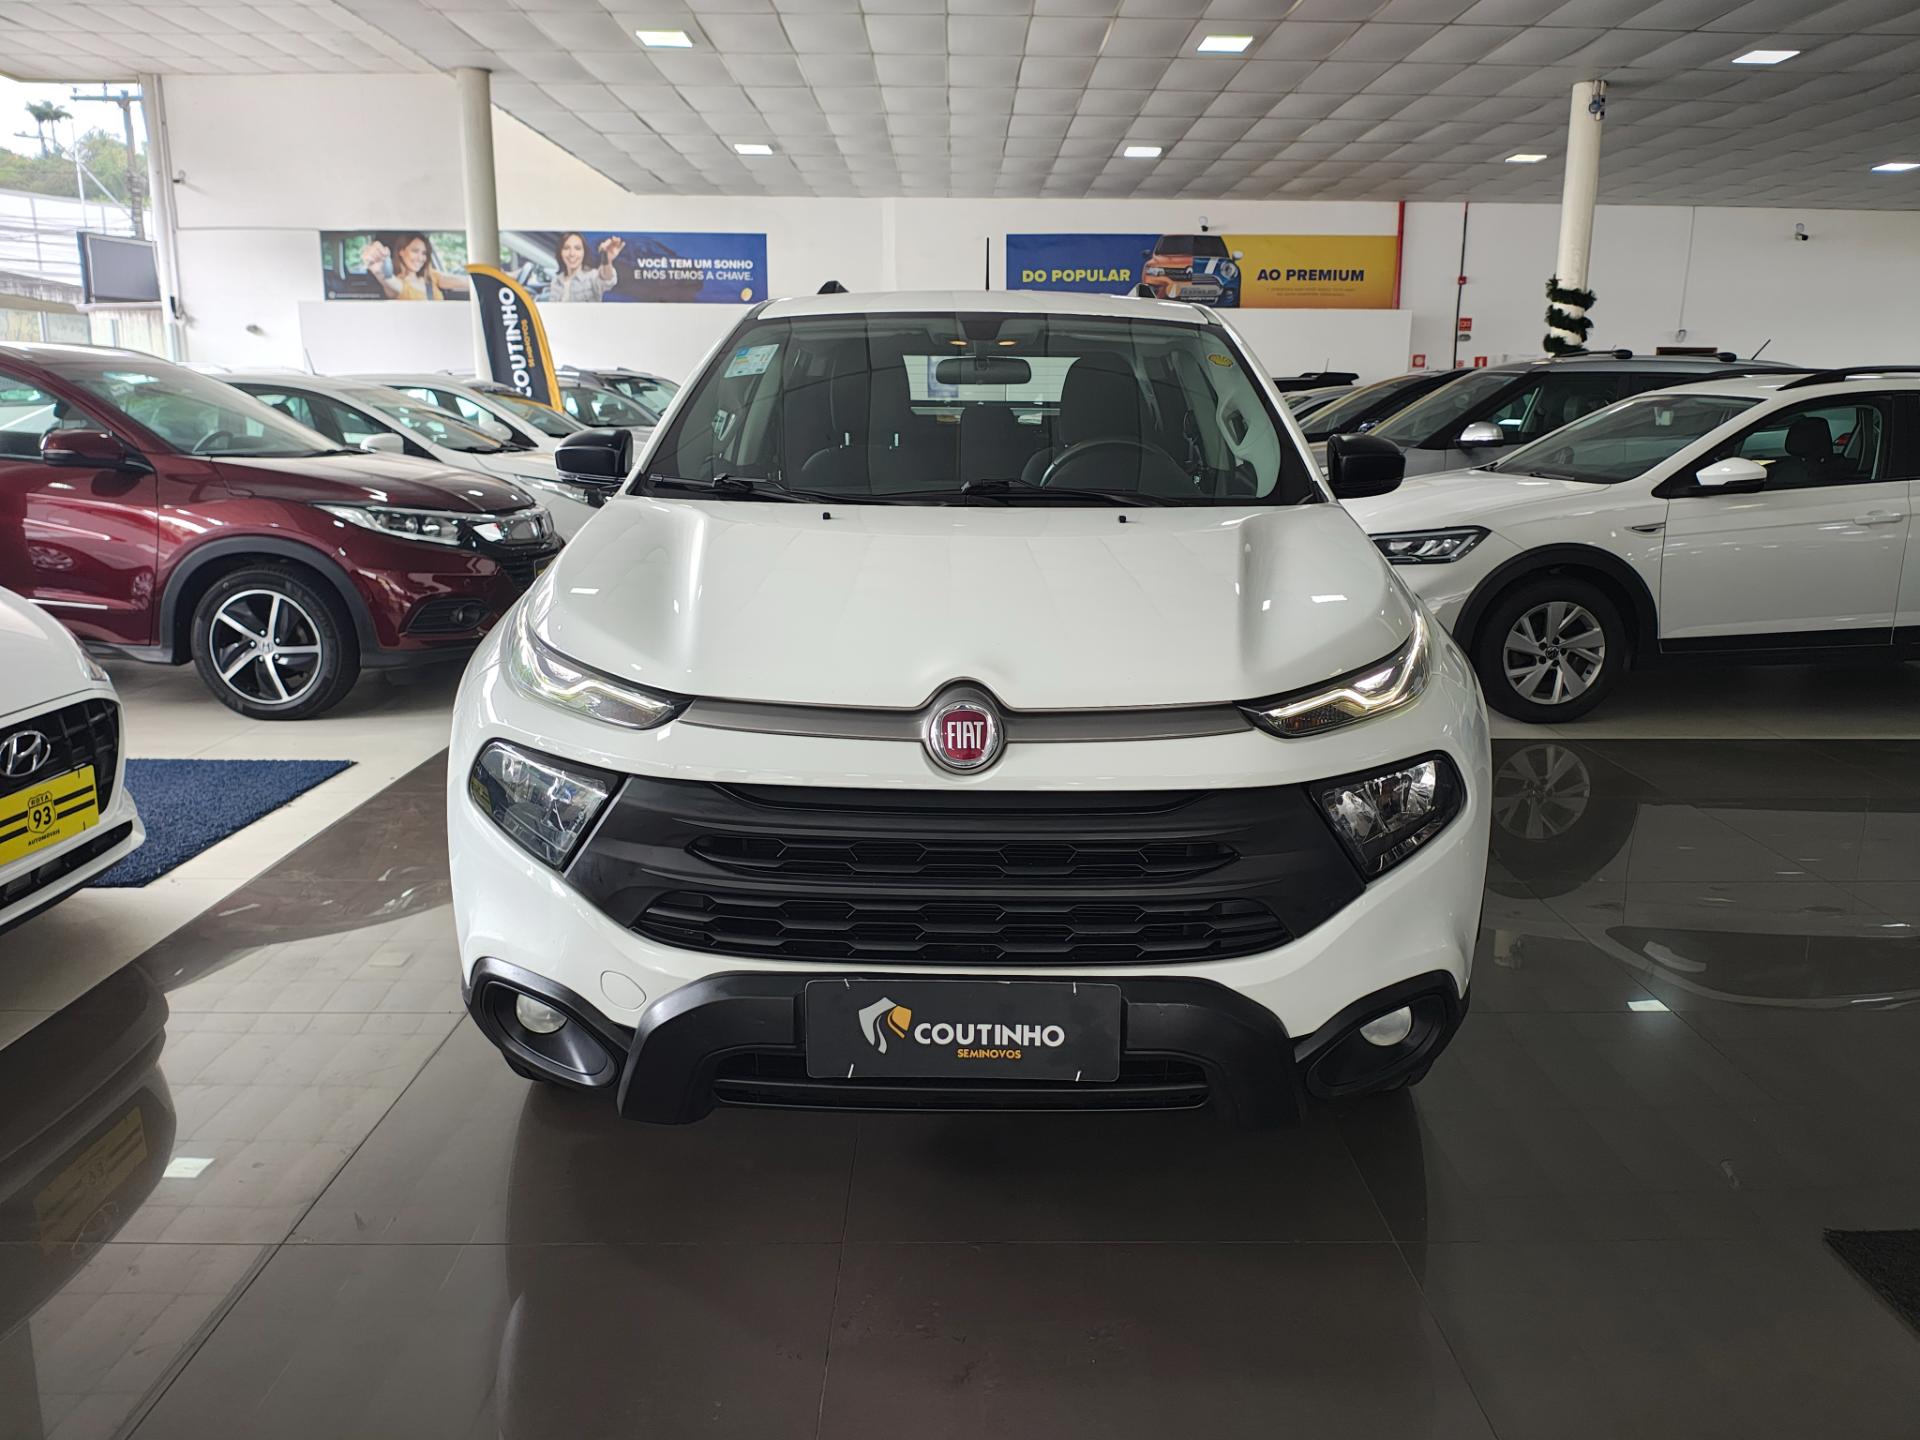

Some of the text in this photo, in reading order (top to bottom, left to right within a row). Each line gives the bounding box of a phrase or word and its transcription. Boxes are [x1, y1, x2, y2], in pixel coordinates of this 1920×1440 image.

[637, 257, 753, 270] VOCÊ TEM UM SONHO
[634, 269, 753, 281] E NÓS TEMOS A CHAVE.
[1022, 269, 1130, 283] DO POPULAR
[1257, 269, 1365, 282] AO PREMIUM
[947, 721, 984, 749] FIAT
[33, 806, 52, 829] 93
[914, 1022, 1065, 1047] COUTINHO
[957, 1048, 1022, 1059] SEMINOVOS
